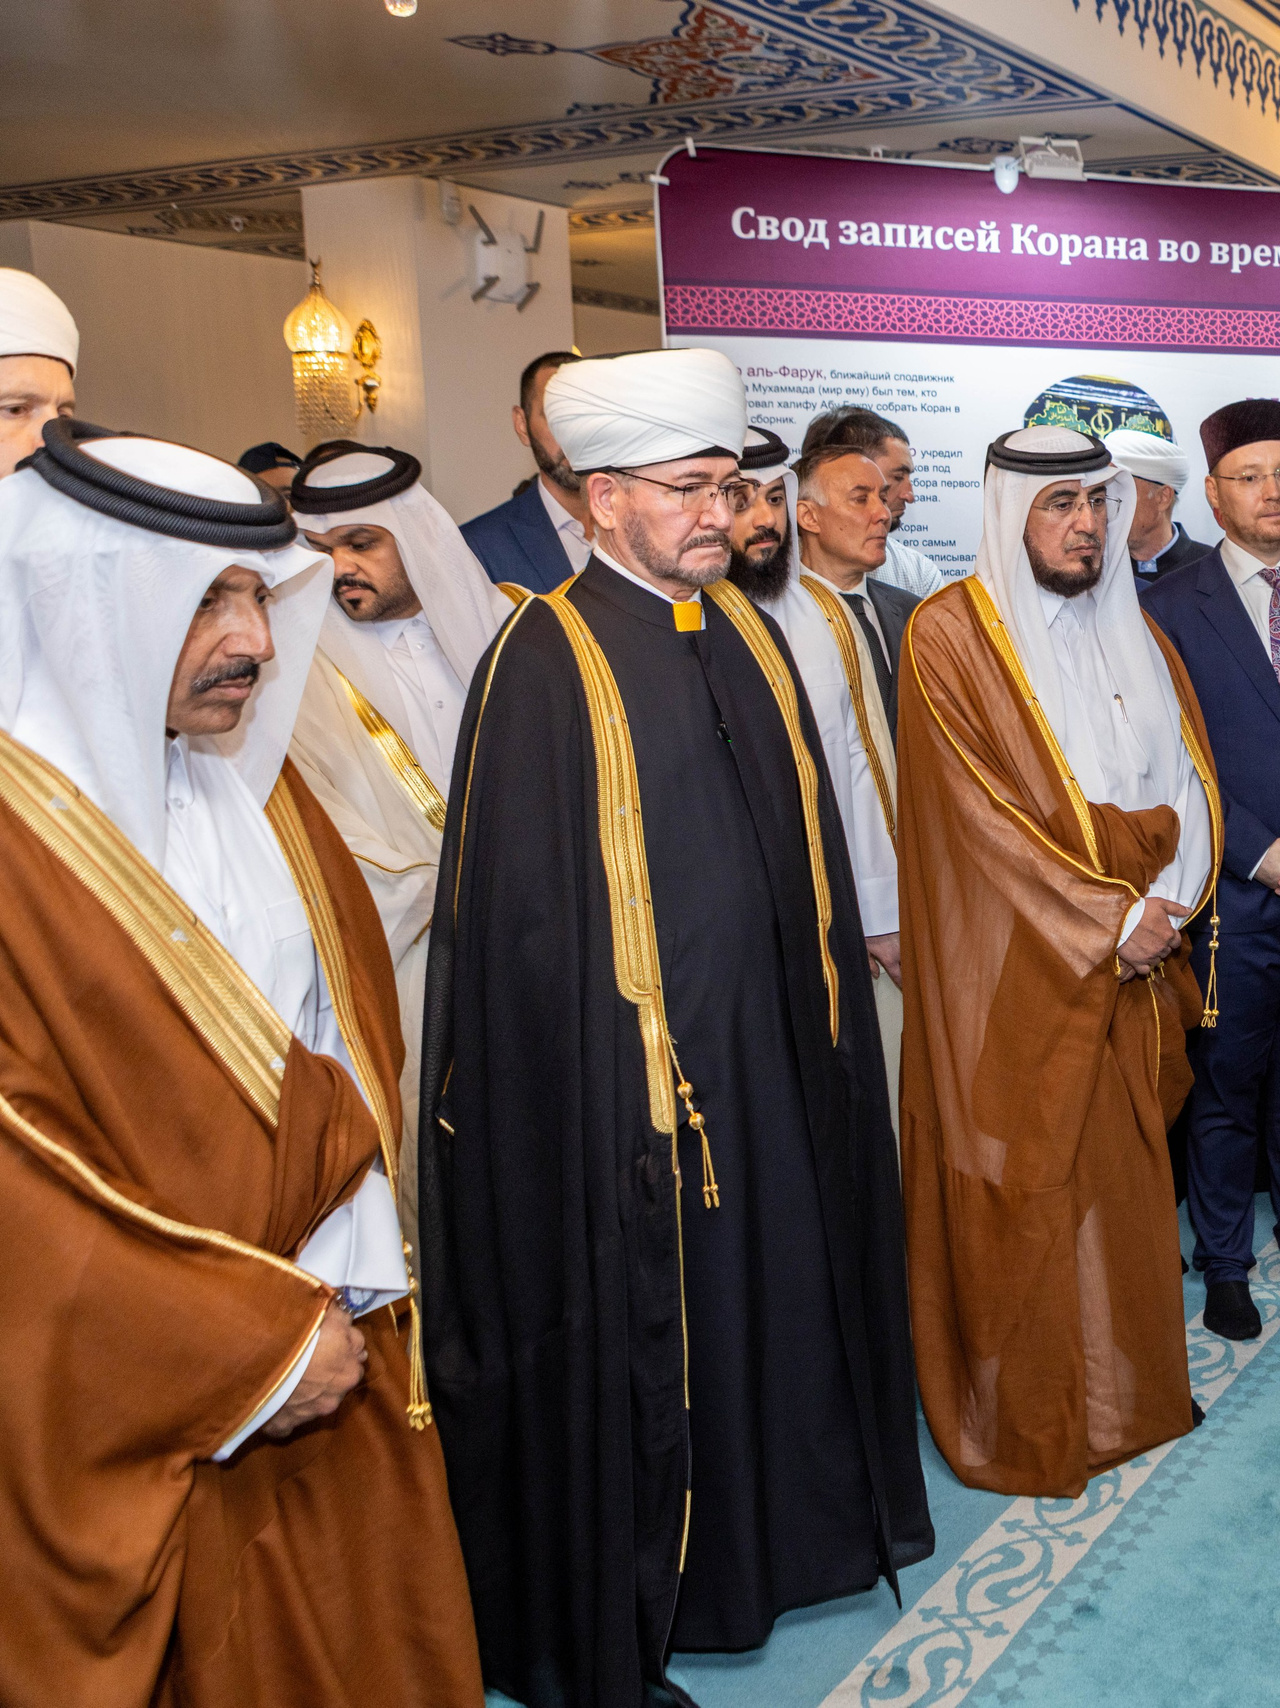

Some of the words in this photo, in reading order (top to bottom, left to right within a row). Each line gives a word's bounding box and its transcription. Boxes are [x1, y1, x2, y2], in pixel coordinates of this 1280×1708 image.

[730, 207, 829, 250] Свод
[839, 222, 1000, 253] записей
[1012, 224, 1149, 265] Корана
[1158, 242, 1200, 264] во
[747, 366, 827, 384] аль-Фарук,
[830, 369, 891, 381] ближайший
[894, 373, 954, 384] сподвижник
[752, 384, 815, 394] Мухаммада
[819, 386, 842, 396] (мир
[846, 386, 870, 397] ему)
[872, 387, 893, 396] был
[897, 390, 918, 398] тем,
[921, 390, 937, 398] кто
[778, 400, 816, 411] халифу
[876, 402, 918, 414] собрать
[921, 403, 951, 414] Коран
[751, 415, 797, 425] сборник.
[921, 450, 962, 459] учредил
[933, 466, 950, 474] под
[941, 480, 980, 489] первого
[904, 540, 919, 548] его
